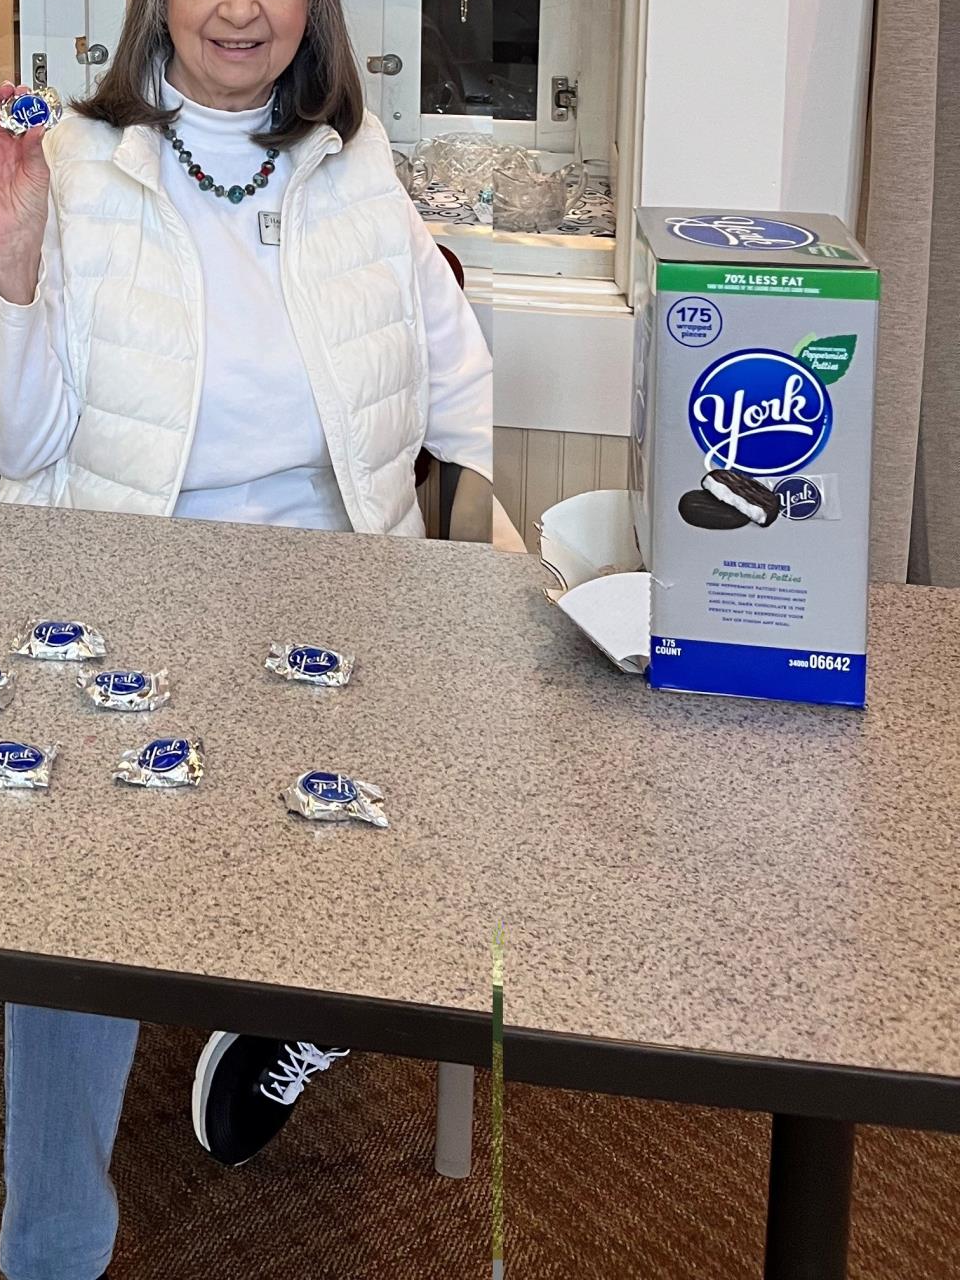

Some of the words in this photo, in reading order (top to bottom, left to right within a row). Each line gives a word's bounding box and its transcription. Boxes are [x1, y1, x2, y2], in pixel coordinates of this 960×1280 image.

[12, 98, 46, 129] York
[724, 273, 746, 285] 70%
[748, 275, 778, 286] LESS
[781, 276, 805, 287] FAT
[676, 307, 712, 323] 175
[676, 324, 713, 333] wrapped
[693, 373, 820, 471] York
[776, 483, 816, 519] York
[737, 561, 767, 570] CHOCOLATE
[712, 568, 766, 580] Peppermint
[770, 572, 802, 583] Patties
[35, 624, 75, 645] York
[662, 638, 676, 648] 175
[655, 646, 682, 657] COUNT
[289, 651, 331, 673] York
[809, 654, 850, 671] 06642
[96, 673, 141, 695] York
[142, 739, 182, 770] York
[309, 773, 353, 796] York
